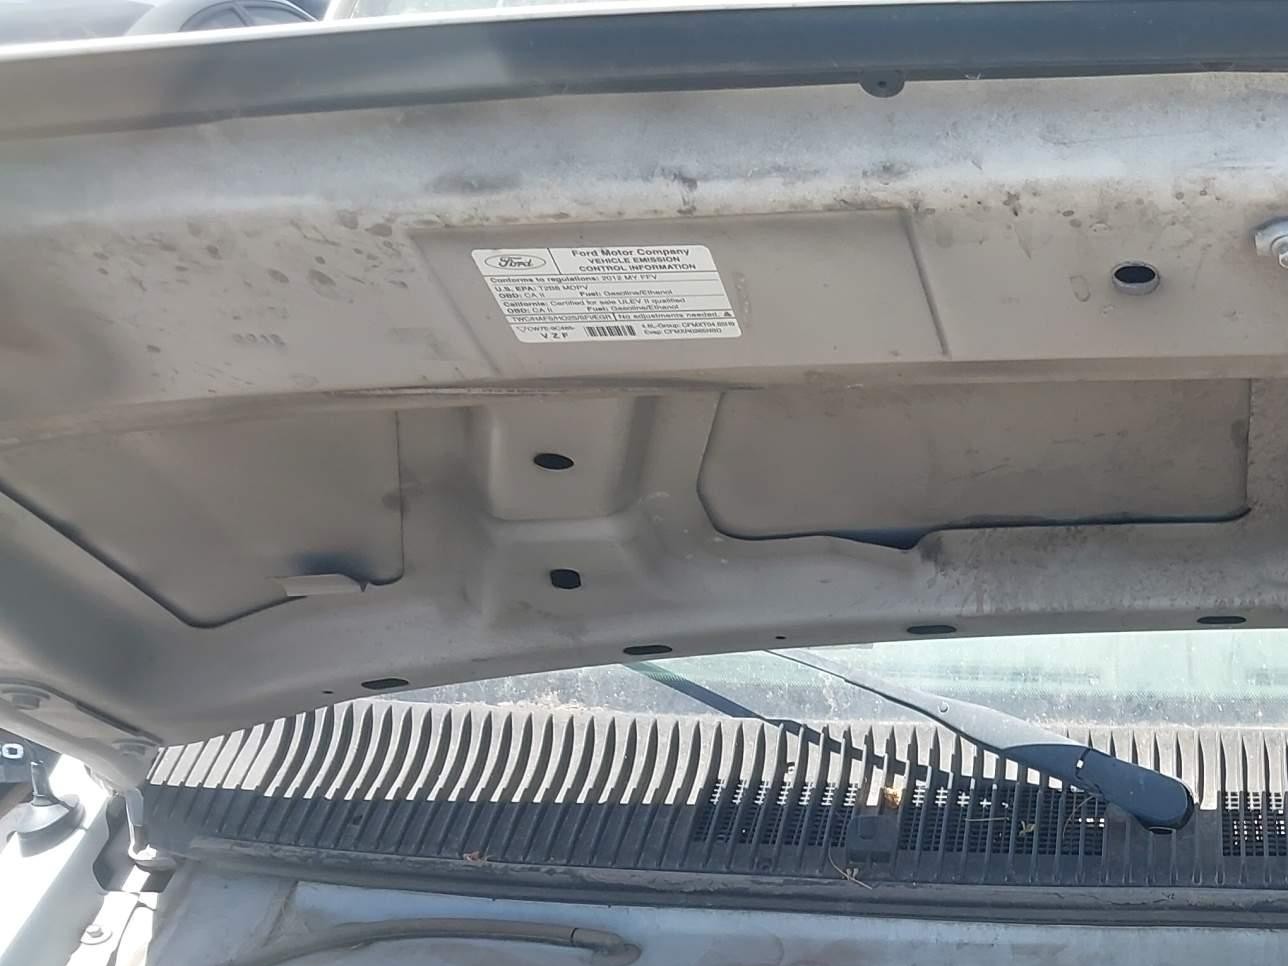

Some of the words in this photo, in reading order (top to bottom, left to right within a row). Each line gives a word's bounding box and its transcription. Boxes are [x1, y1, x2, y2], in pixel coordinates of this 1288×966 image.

[571, 249, 598, 257] Ford
[601, 248, 633, 257] Motor
[636, 248, 690, 257] Company
[498, 256, 532, 268] Ford
[587, 257, 630, 265] VEHICLE
[579, 264, 627, 272] CONTROL
[629, 263, 696, 271] INFORMATION
